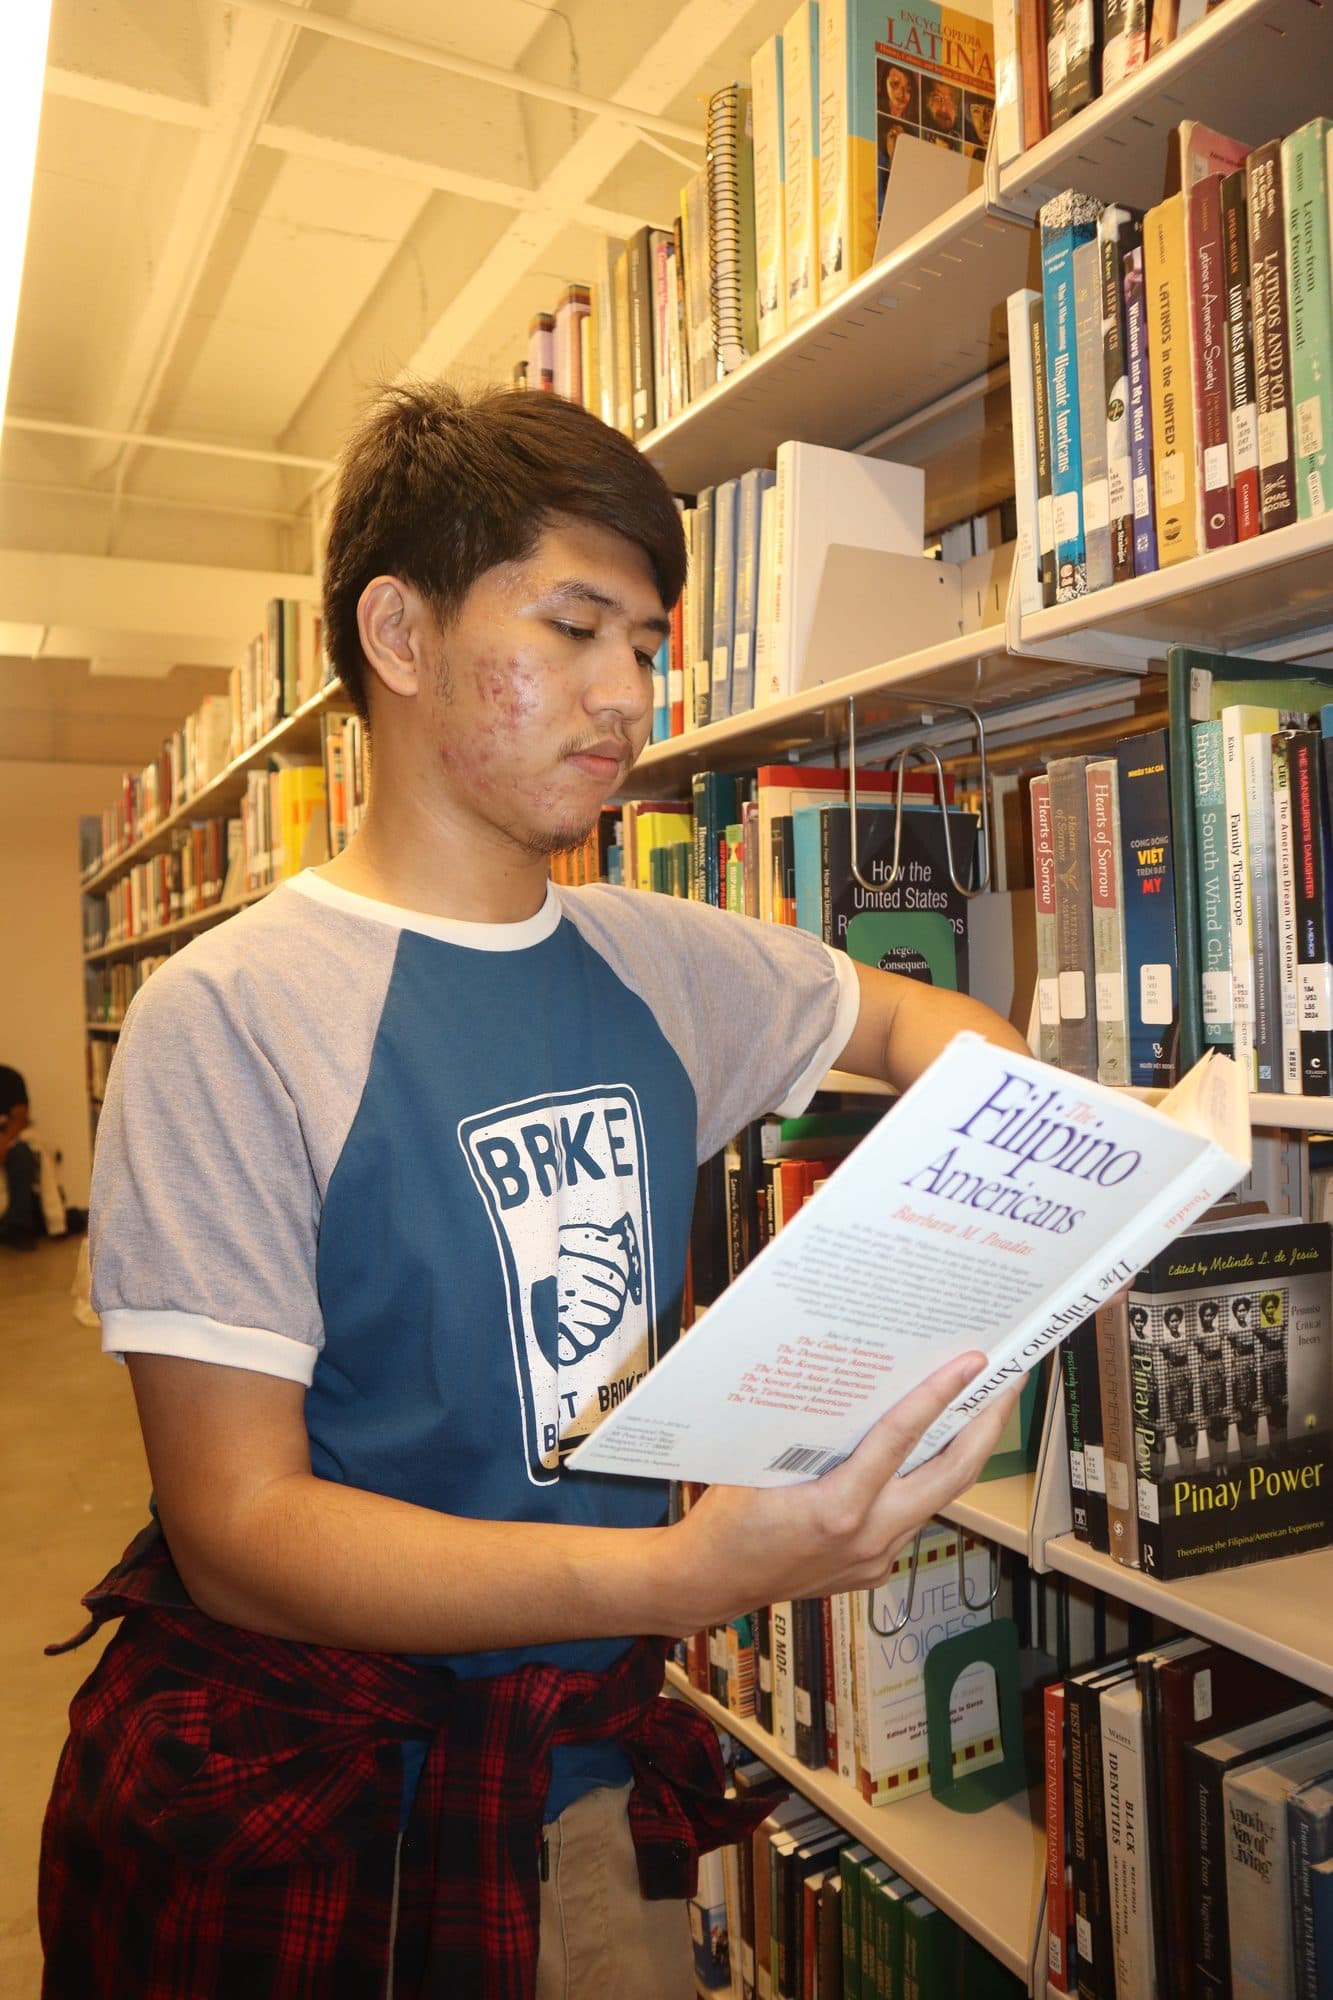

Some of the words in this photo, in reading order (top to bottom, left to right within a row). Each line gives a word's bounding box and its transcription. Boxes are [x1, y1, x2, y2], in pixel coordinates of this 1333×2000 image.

[887, 16, 993, 81] LATINA
[900, 9, 981, 49] ENCYCLOPEDIA
[1290, 208, 1299, 230] the
[1303, 200, 1313, 254] Letters
[1199, 242, 1216, 281] Latinos
[1252, 262, 1264, 275] A
[1291, 234, 1304, 305] Promised
[1306, 255, 1316, 292] from
[1202, 281, 1213, 293] in
[1229, 284, 1242, 321] LATINO
[1254, 275, 1265, 314] Select
[1264, 251, 1281, 329] LATINOS
[1128, 302, 1140, 358] Windows
[1157, 281, 1172, 344] LATINOS
[1201, 292, 1220, 347] American
[1292, 308, 1305, 350] Land:
[1161, 349, 1172, 362] in
[1231, 322, 1245, 353] MASS
[1255, 317, 1268, 373] Research
[1266, 332, 1283, 372] AND
[1053, 353, 1070, 406] Hispanic
[1131, 359, 1141, 384] into
[1162, 365, 1173, 388] the
[1202, 346, 1222, 391] Society
[1232, 353, 1246, 409] MOBILIZATI
[1131, 385, 1142, 404] My
[1257, 375, 1271, 414] Biblio
[1133, 406, 1144, 442] World
[1163, 392, 1175, 445] UNITED
[1055, 409, 1072, 473] Americans
[1116, 531, 1126, 564] Strategist
[1227, 736, 1235, 762] Kibria
[1298, 747, 1308, 767] THE
[1278, 765, 1287, 788] LIEU
[1038, 797, 1050, 838] Hearts
[1055, 809, 1065, 821] of
[1095, 784, 1108, 828] Hearts
[1280, 800, 1289, 815] The
[1299, 769, 1311, 841] MANICURIST'S
[1040, 842, 1053, 854] of
[1057, 822, 1066, 861] Sorrow
[1068, 816, 1078, 851] Hearts
[1094, 832, 1111, 845] of
[1202, 813, 1219, 872] South
[1230, 814, 1242, 856] Family
[1281, 823, 1290, 876] American
[872, 860, 905, 881] How
[910, 861, 931, 881] the
[1041, 858, 1054, 904] Sorrow
[1097, 849, 1111, 897] Sorrow
[1304, 844, 1314, 899] DAUGHTER
[854, 888, 900, 908] United
[905, 887, 948, 908] States
[1205, 875, 1221, 931] Wind
[1231, 860, 1245, 926] Tightrope
[1283, 880, 1291, 916] Dream
[1285, 920, 1293, 930] in
[1307, 927, 1315, 957] MEMOIR
[878, 959, 929, 972] Consequen
[949, 1070, 1142, 1188] Filipino
[901, 1146, 1086, 1235] Americans
[891, 1204, 958, 1235] Barbara
[958, 1224, 980, 1241] M.
[1101, 1258, 1139, 1292] The
[1168, 1263, 1195, 1276] Edited
[1197, 1261, 1207, 1275] by
[1210, 1254, 1254, 1271] Melinda
[1258, 1251, 1270, 1264] L.
[1274, 1250, 1286, 1262] de
[1022, 1292, 1102, 1359] Filipino
[951, 1358, 1024, 1415] Americ
[1063, 1350, 1077, 1387] positively
[1133, 1354, 1153, 1421] Pinay
[1070, 1390, 1078, 1399] no
[1068, 1403, 1080, 1434] filipinos
[1135, 1427, 1155, 1480] Pow
[1174, 1476, 1242, 1518] Pinay
[1250, 1462, 1325, 1501] Power
[1176, 1541, 1214, 1558] Theorizing
[1214, 1541, 1227, 1552] the
[1288, 1521, 1325, 1537] Experience
[883, 1577, 975, 1634] MUTED
[887, 1727, 907, 1739] Edited
[909, 1724, 916, 1733] by
[1046, 1709, 1056, 1736] THE
[1069, 1703, 1081, 1737] WEST
[1108, 1727, 1131, 1745] Waters
[1047, 1740, 1057, 1774] WEST
[1071, 1739, 1083, 1779] INDIAN
[1047, 1775, 1057, 1822] INDIAN
[1108, 1752, 1120, 1846] IDENTITIES
[1199, 1784, 1209, 1850] Americans
[1073, 1782, 1086, 1860] IMMIGRANTS
[1125, 1800, 1136, 1855] BLACK
[1046, 1823, 1058, 1886] DIASPORA
[1201, 1856, 1212, 1886] from
